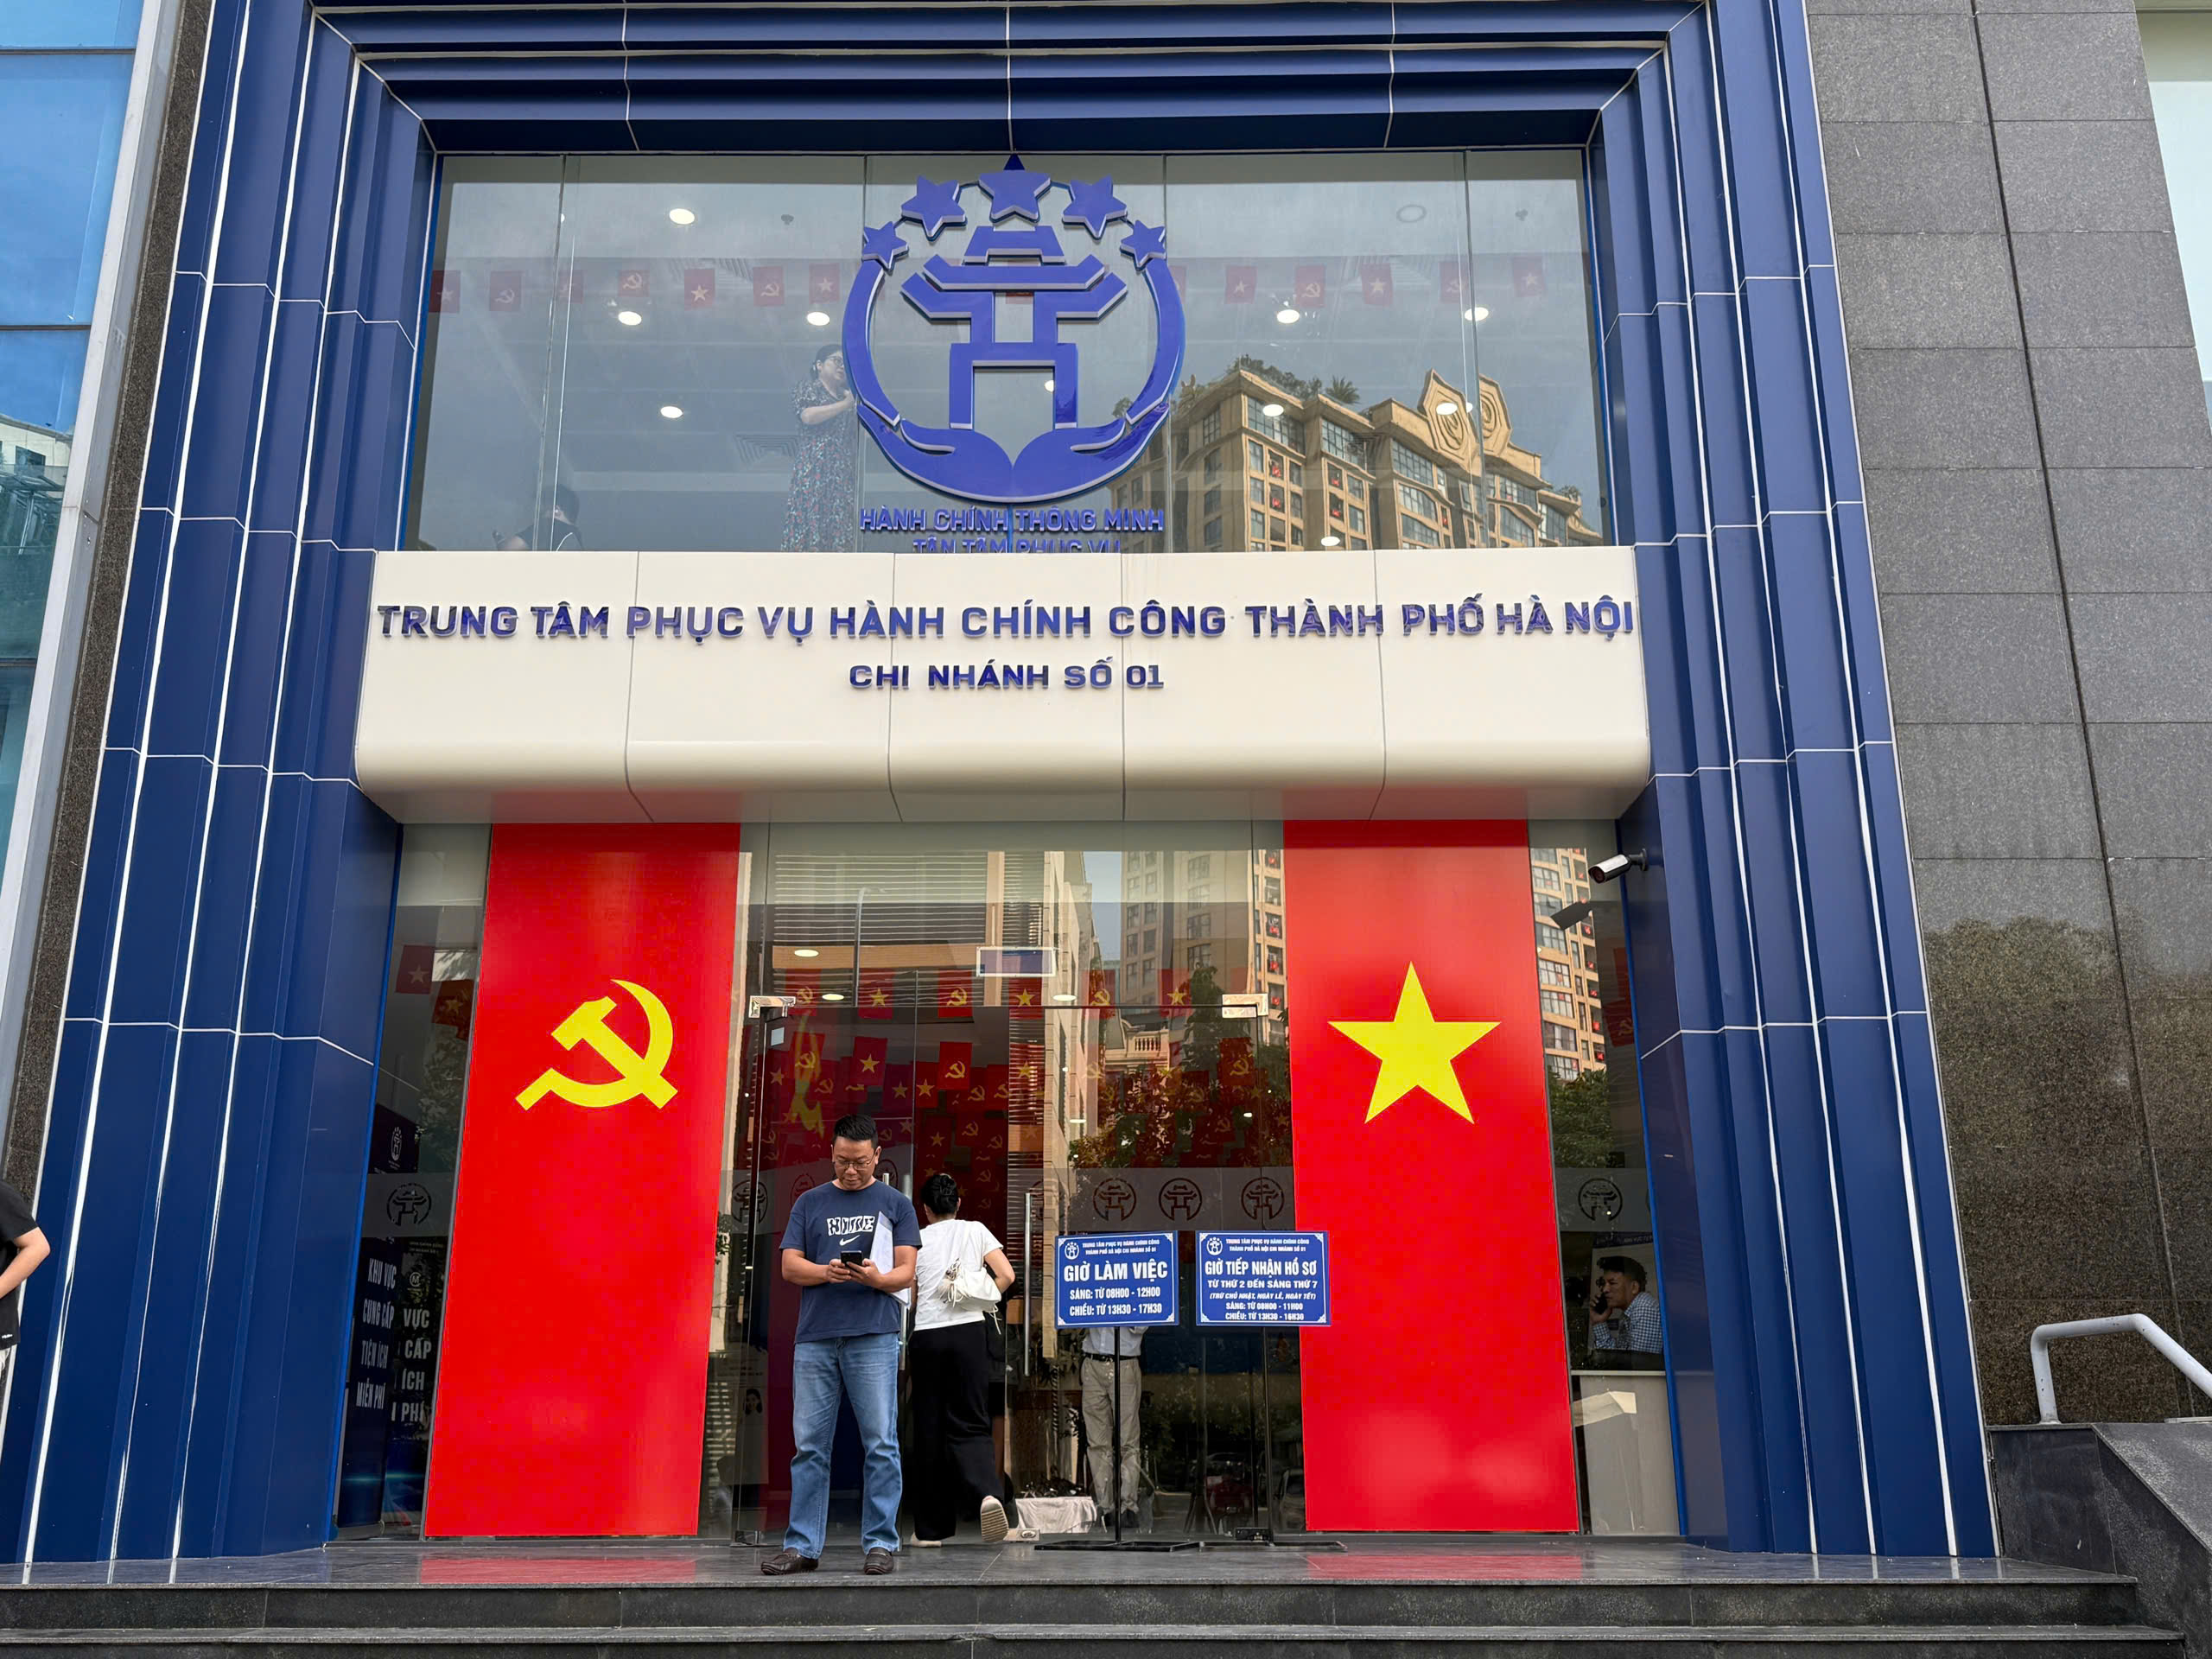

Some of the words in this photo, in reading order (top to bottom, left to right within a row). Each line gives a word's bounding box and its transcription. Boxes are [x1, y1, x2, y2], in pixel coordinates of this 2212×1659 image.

[859, 505, 926, 531] HÀNH
[933, 505, 1009, 531] CHÍNH
[1014, 505, 1096, 532] THÔNG
[1103, 508, 1164, 531] MINH
[378, 605, 518, 638] TRUNG
[530, 601, 609, 638] TÂM
[626, 606, 745, 645] PHỤC
[757, 606, 814, 645] VỤ
[830, 600, 944, 639] HÀNH
[961, 599, 1090, 638] CHÍNH
[1109, 599, 1226, 638] CÔNG
[1244, 598, 1383, 638] THÀNH
[1402, 593, 1484, 636] PHỐ
[1496, 594, 1554, 636] HÀ
[1564, 594, 1633, 641] NỘI
[849, 664, 910, 690] CHI
[928, 658, 1049, 690] NHÁNH
[1064, 656, 1114, 690] SỐ
[1126, 664, 1165, 690] 01
[367, 1257, 384, 1285] KHU
[1064, 1261, 1090, 1281] GIỜ
[1094, 1260, 1128, 1281] LÀM
[1132, 1258, 1167, 1282] VIỆC
[1205, 1257, 1224, 1275] GIỜ
[1225, 1256, 1249, 1275] TIẾP
[1251, 1258, 1281, 1278] NHẬN
[1301, 1260, 1317, 1276] SƠ
[1070, 1287, 1093, 1300] SÁNG:
[1095, 1287, 1105, 1299] TỪ
[1106, 1287, 1129, 1299] 08H00
[1136, 1287, 1160, 1298] 12H00
[1207, 1279, 1219, 1288] TỪ
[1221, 1279, 1238, 1288] THỨ
[1247, 1278, 1265, 1288] ĐẾN
[1267, 1279, 1291, 1288] SÁNG
[1294, 1279, 1311, 1288] THỨ
[362, 1298, 381, 1326] CUNG
[1096, 1303, 1106, 1315] TỪ
[1108, 1303, 1131, 1314] 13H30
[1138, 1303, 1162, 1314] 17H30
[1225, 1301, 1246, 1310] SÁNG:
[1247, 1300, 1256, 1310] TỪ
[1248, 1311, 1257, 1320] TỪ
